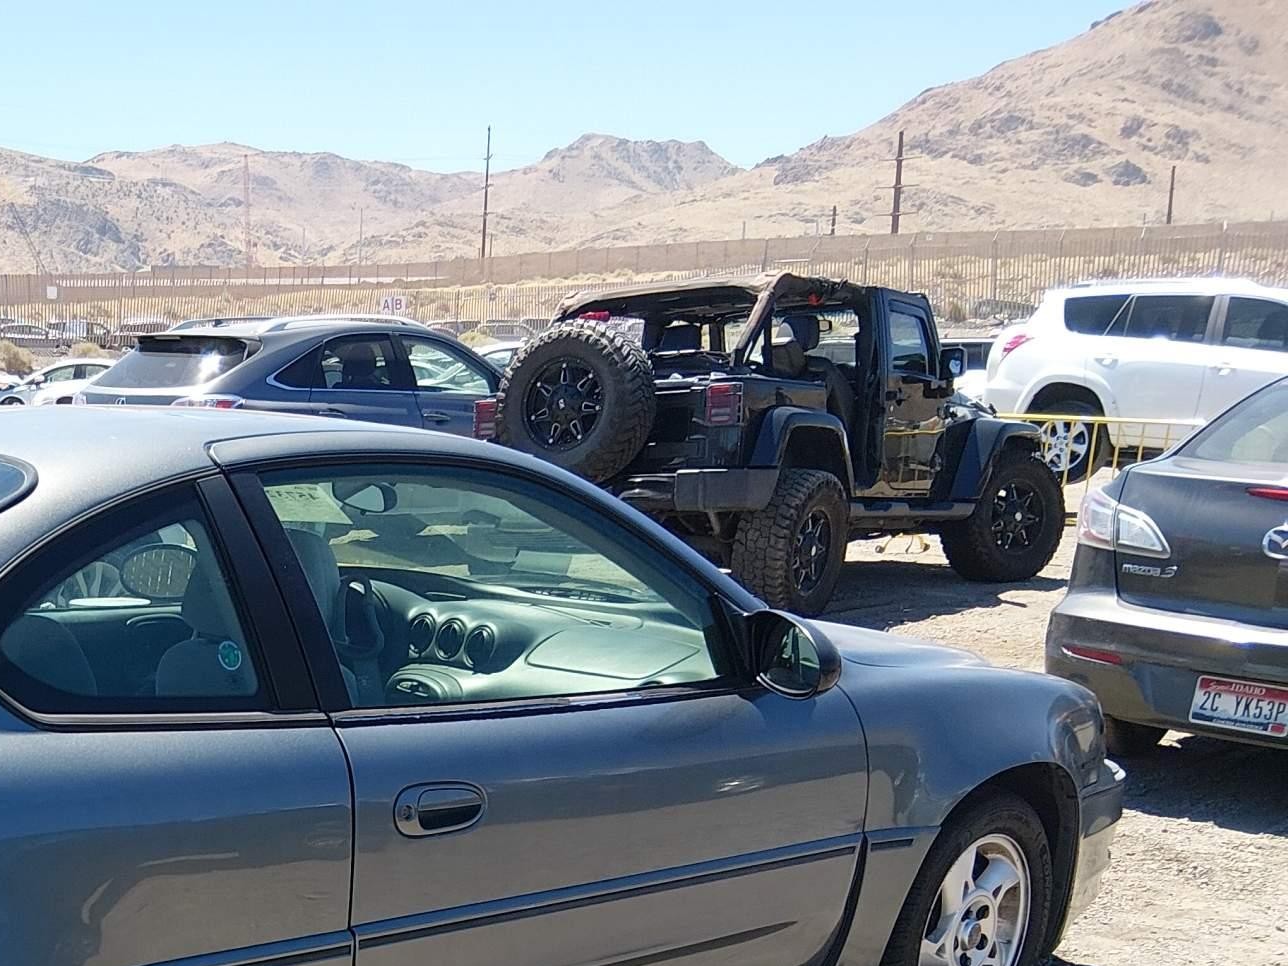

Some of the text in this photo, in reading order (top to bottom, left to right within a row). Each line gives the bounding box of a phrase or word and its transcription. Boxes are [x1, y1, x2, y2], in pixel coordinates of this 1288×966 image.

[382, 299, 402, 310] A B
[1230, 683, 1266, 696] IDAHO
[1199, 690, 1221, 712] 2C
